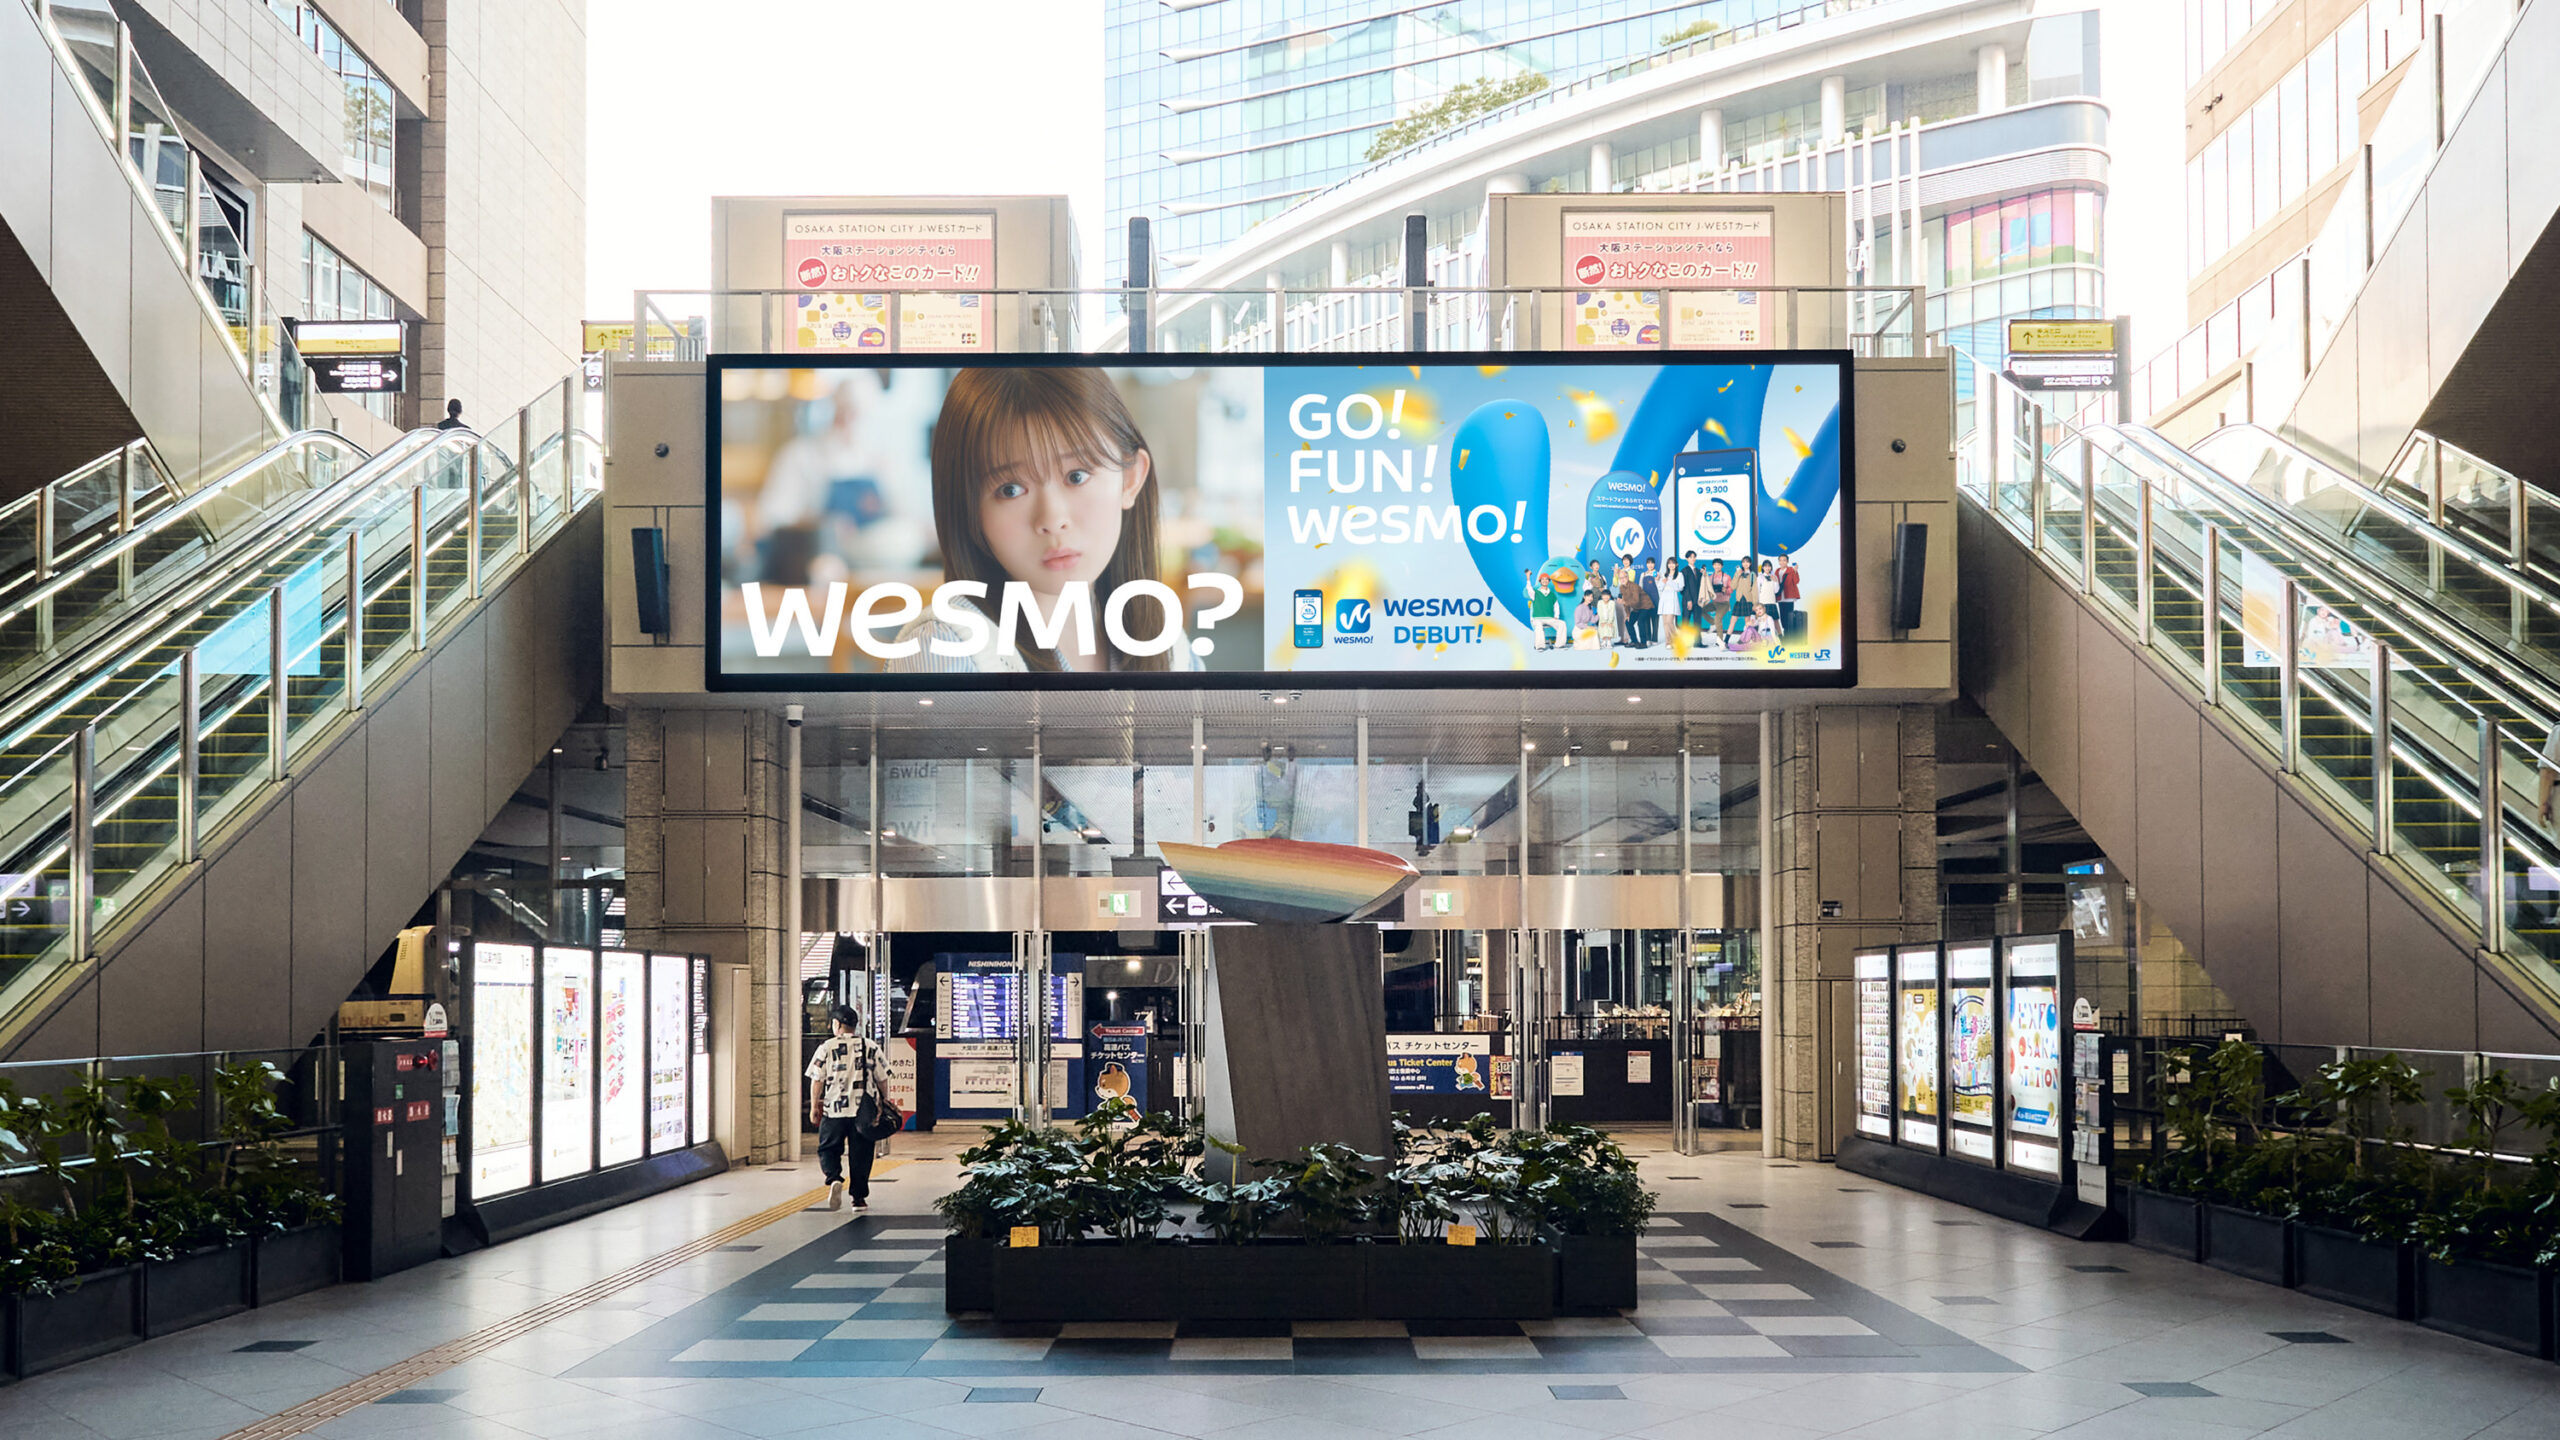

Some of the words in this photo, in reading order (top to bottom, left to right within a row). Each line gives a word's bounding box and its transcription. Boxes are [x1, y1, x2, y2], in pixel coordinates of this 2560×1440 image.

[794, 224, 833, 234] OSAKA
[838, 224, 886, 234] STATION
[890, 224, 914, 234] CITY
[1572, 221, 1612, 231] OSAKA
[1616, 221, 1664, 231] STATION
[1668, 221, 1692, 231] CITY
[821, 245, 957, 256] 大阪ステーションシティなら
[1599, 242, 1734, 253] 大阪ステーションシティなら
[1289, 389, 1407, 440] GO!
[1290, 444, 1439, 494] FUN!
[1705, 485, 1729, 494] 9,300
[1704, 510, 1721, 522] 62
[1394, 624, 1484, 645] DEBUT!
[1814, 649, 1831, 659] JR
[2018, 1002, 2057, 1031] EXPO
[1404, 1041, 1479, 1050] チケットセンター
[2018, 1032, 2059, 1060] OSAKA
[1090, 1051, 1145, 1060] チケットセンター
[1398, 1059, 1424, 1067] Ticket
[1426, 1059, 1453, 1067] Center
